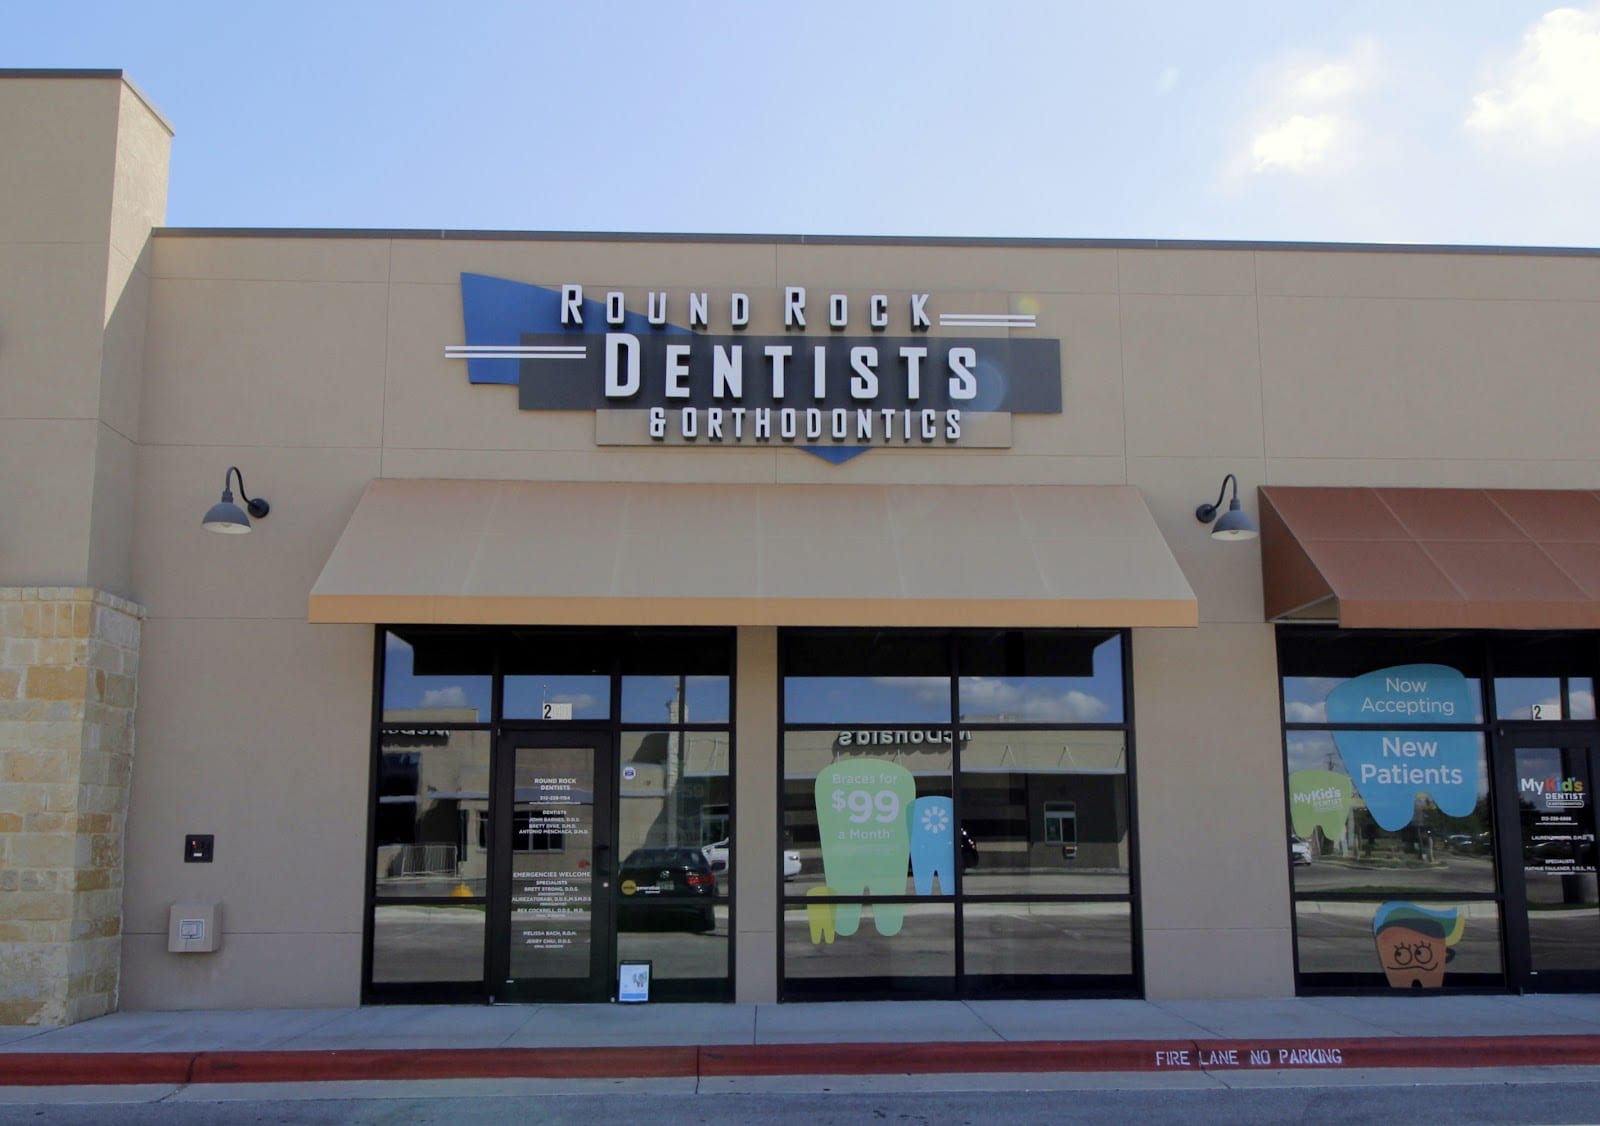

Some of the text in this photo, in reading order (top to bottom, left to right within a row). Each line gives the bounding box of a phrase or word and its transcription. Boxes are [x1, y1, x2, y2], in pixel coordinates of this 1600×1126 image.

[561, 284, 931, 329] ROUND ROCK
[604, 333, 977, 399] DENTISTS
[1386, 677, 1427, 693] Now
[1361, 697, 1455, 716] Accepting
[1382, 737, 1438, 757] New
[832, 773, 898, 784] Braces for
[1360, 763, 1463, 785] Patients
[832, 789, 900, 824] $99
[838, 829, 890, 840] a Month
[1156, 1048, 1342, 1066] FIRE LANE NO PARKING
